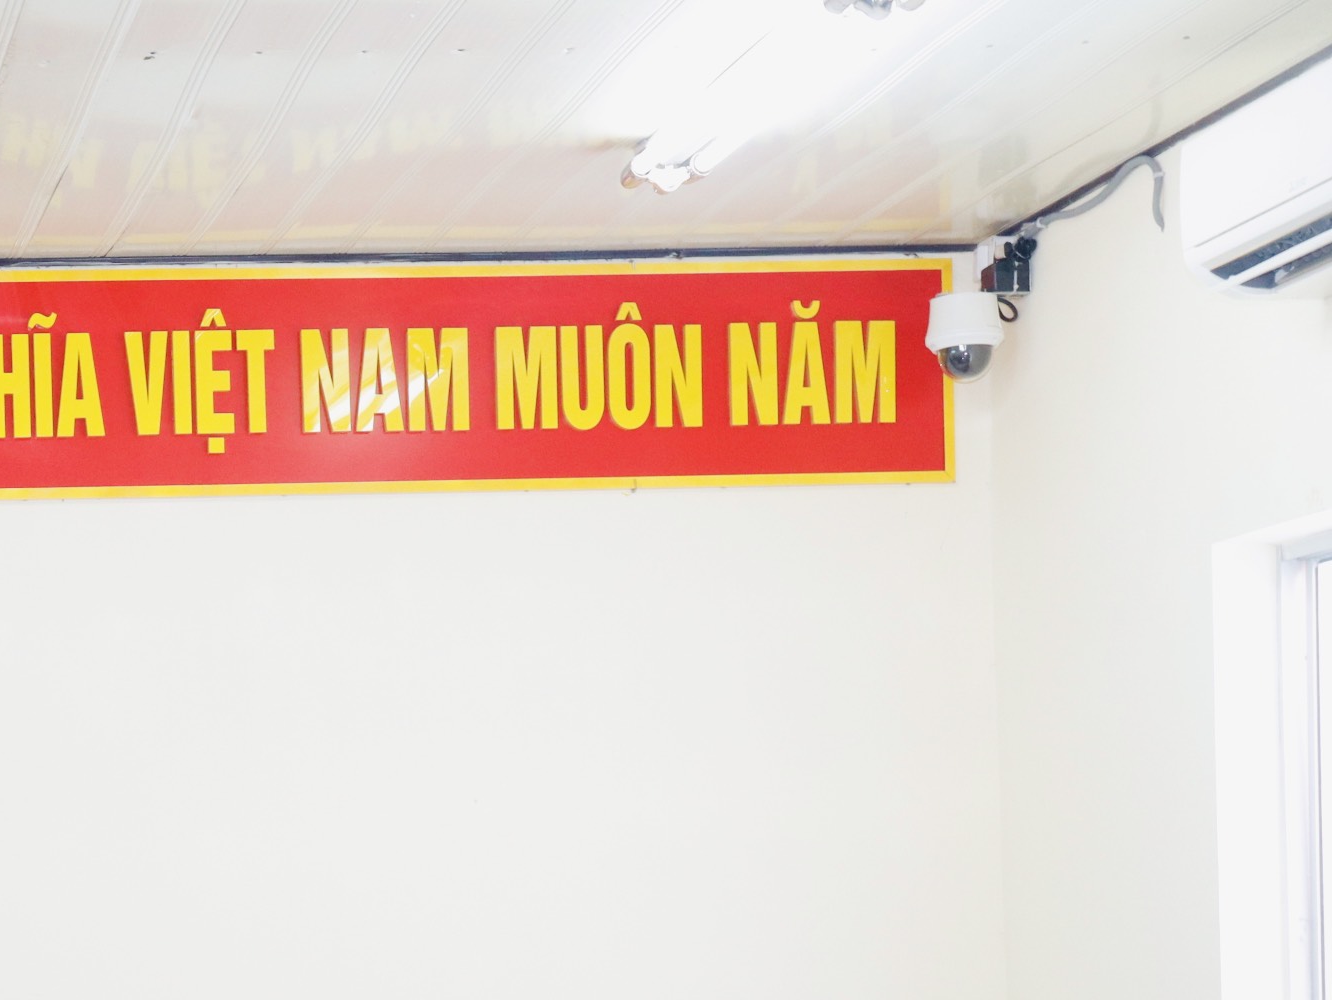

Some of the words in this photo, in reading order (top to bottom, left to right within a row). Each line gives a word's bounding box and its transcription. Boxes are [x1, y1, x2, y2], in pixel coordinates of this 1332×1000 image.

[123, 308, 276, 454] VIỆT
[299, 327, 471, 434] NAM
[494, 301, 703, 431] MUÔN
[728, 300, 897, 426] NĂM
